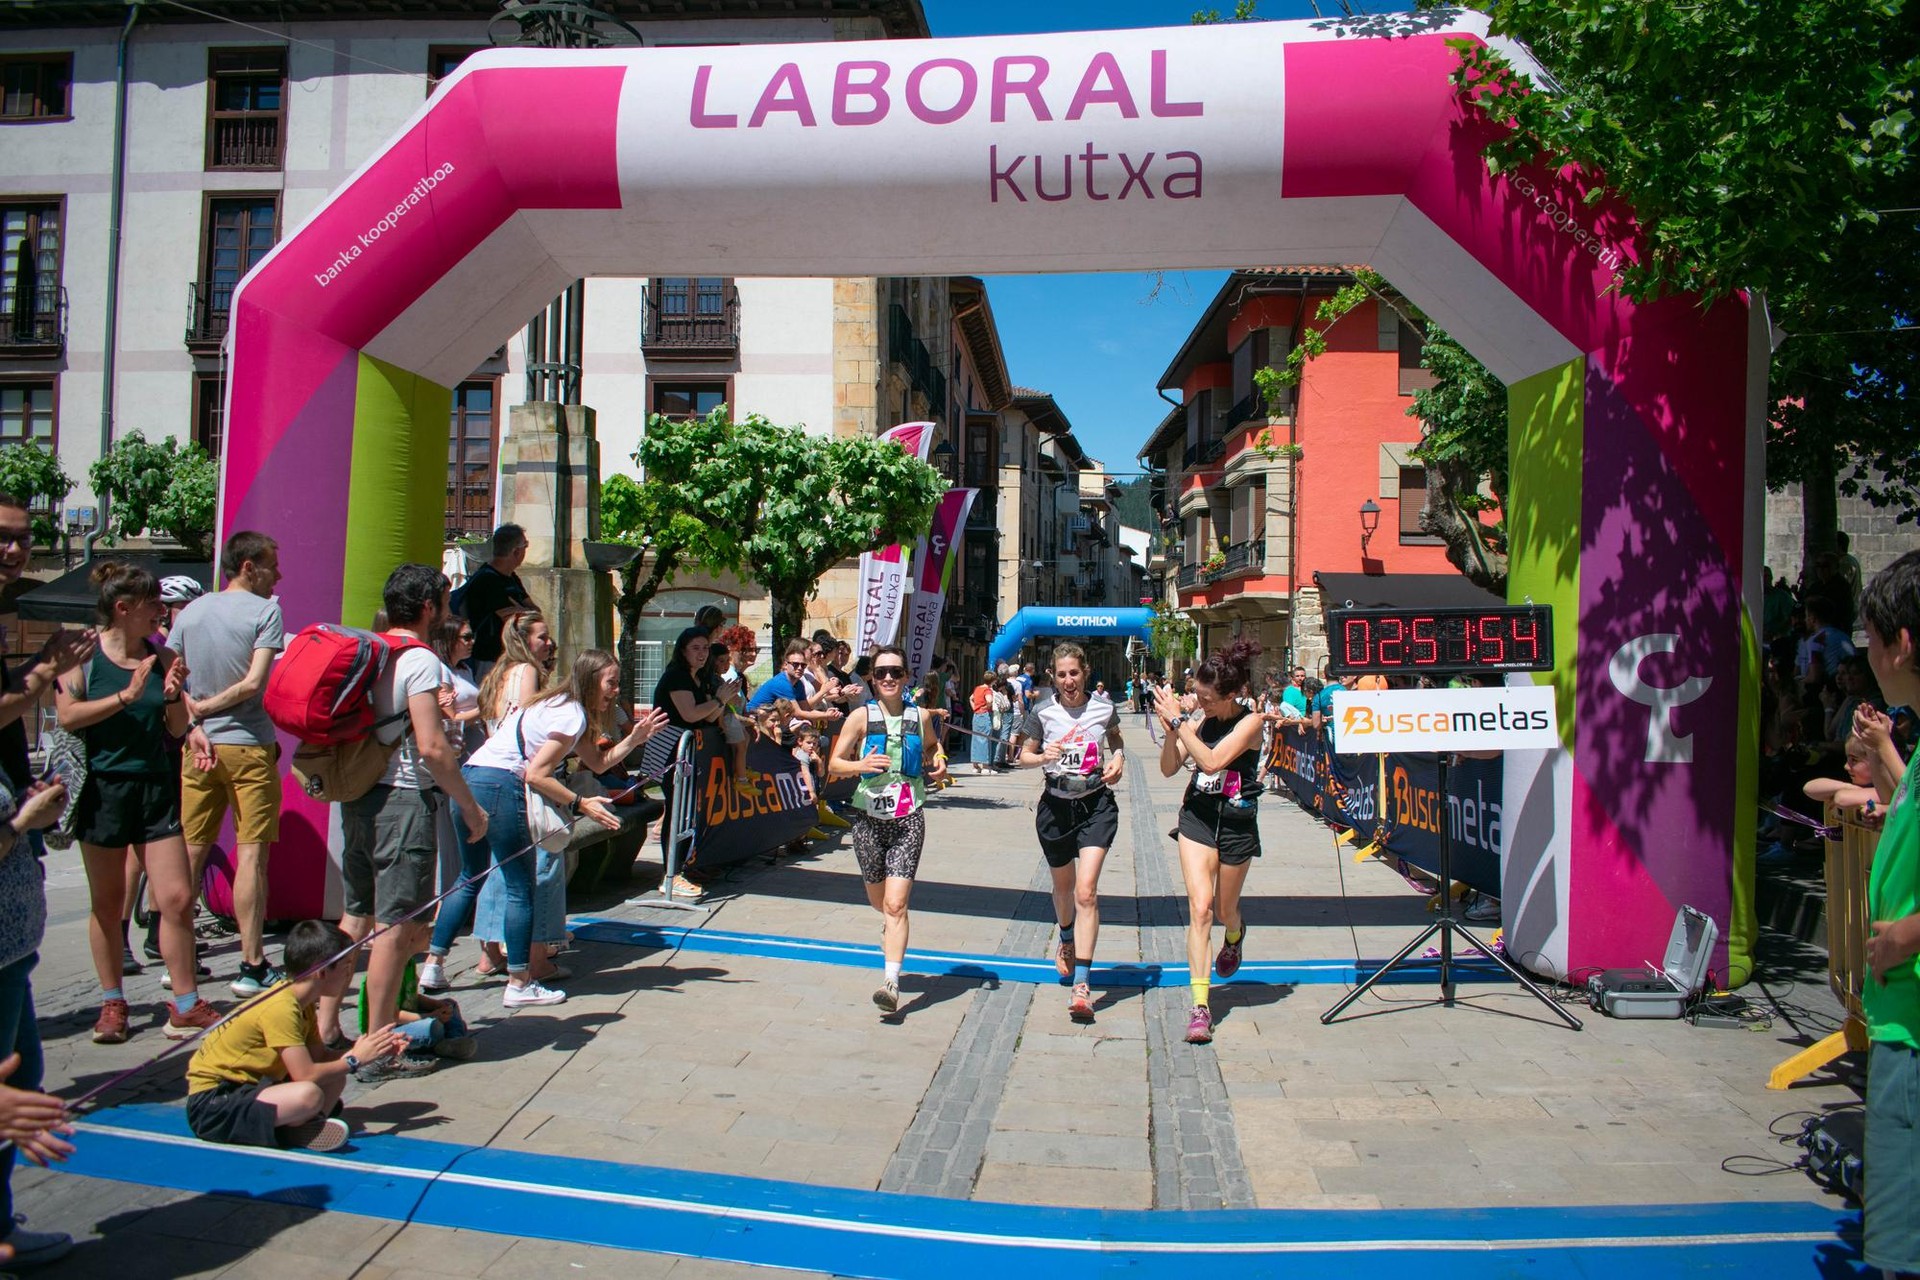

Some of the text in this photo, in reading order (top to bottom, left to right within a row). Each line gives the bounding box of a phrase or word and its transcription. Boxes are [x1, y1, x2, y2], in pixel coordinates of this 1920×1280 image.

[690, 49, 1203, 129] LABORAL
[990, 141, 1203, 203] kutxa
[314, 161, 456, 288] banka kooperatiboa
[861, 572, 885, 653] BORAL
[883, 573, 901, 620] kutxa
[1056, 615, 1118, 627] DECATHLON
[1345, 616, 1538, 665] 02:51:54
[1341, 702, 1549, 737] Buscametas
[1061, 753, 1080, 765] 214
[704, 756, 813, 828] Buscame
[873, 795, 895, 810] 215
[1204, 778, 1221, 792] 216
